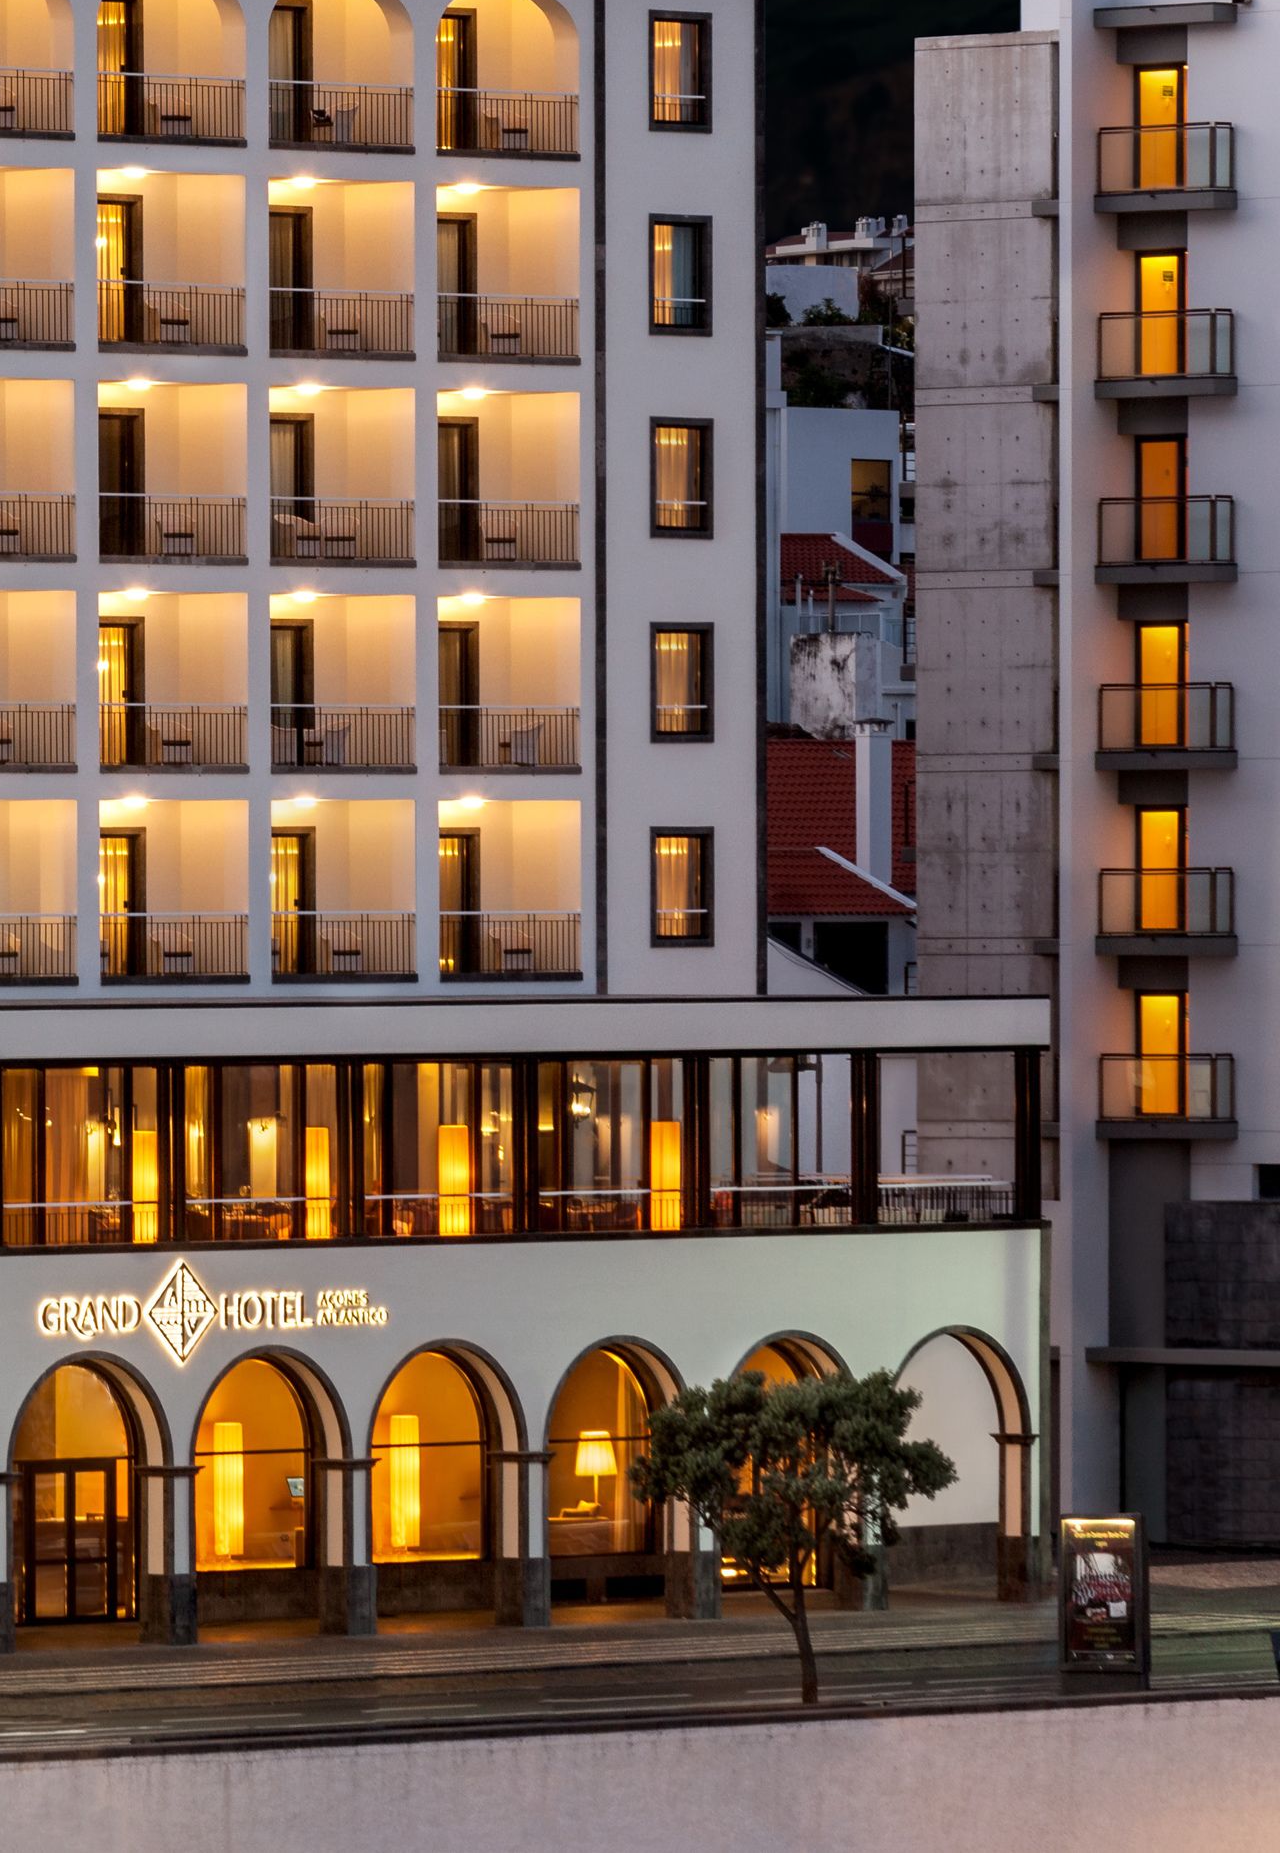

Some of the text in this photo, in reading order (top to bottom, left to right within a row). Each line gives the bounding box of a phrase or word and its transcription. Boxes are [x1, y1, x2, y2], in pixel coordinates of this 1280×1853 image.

[38, 1291, 314, 1339] GRAND HOTEL
[317, 1290, 370, 1310] AÇORES
